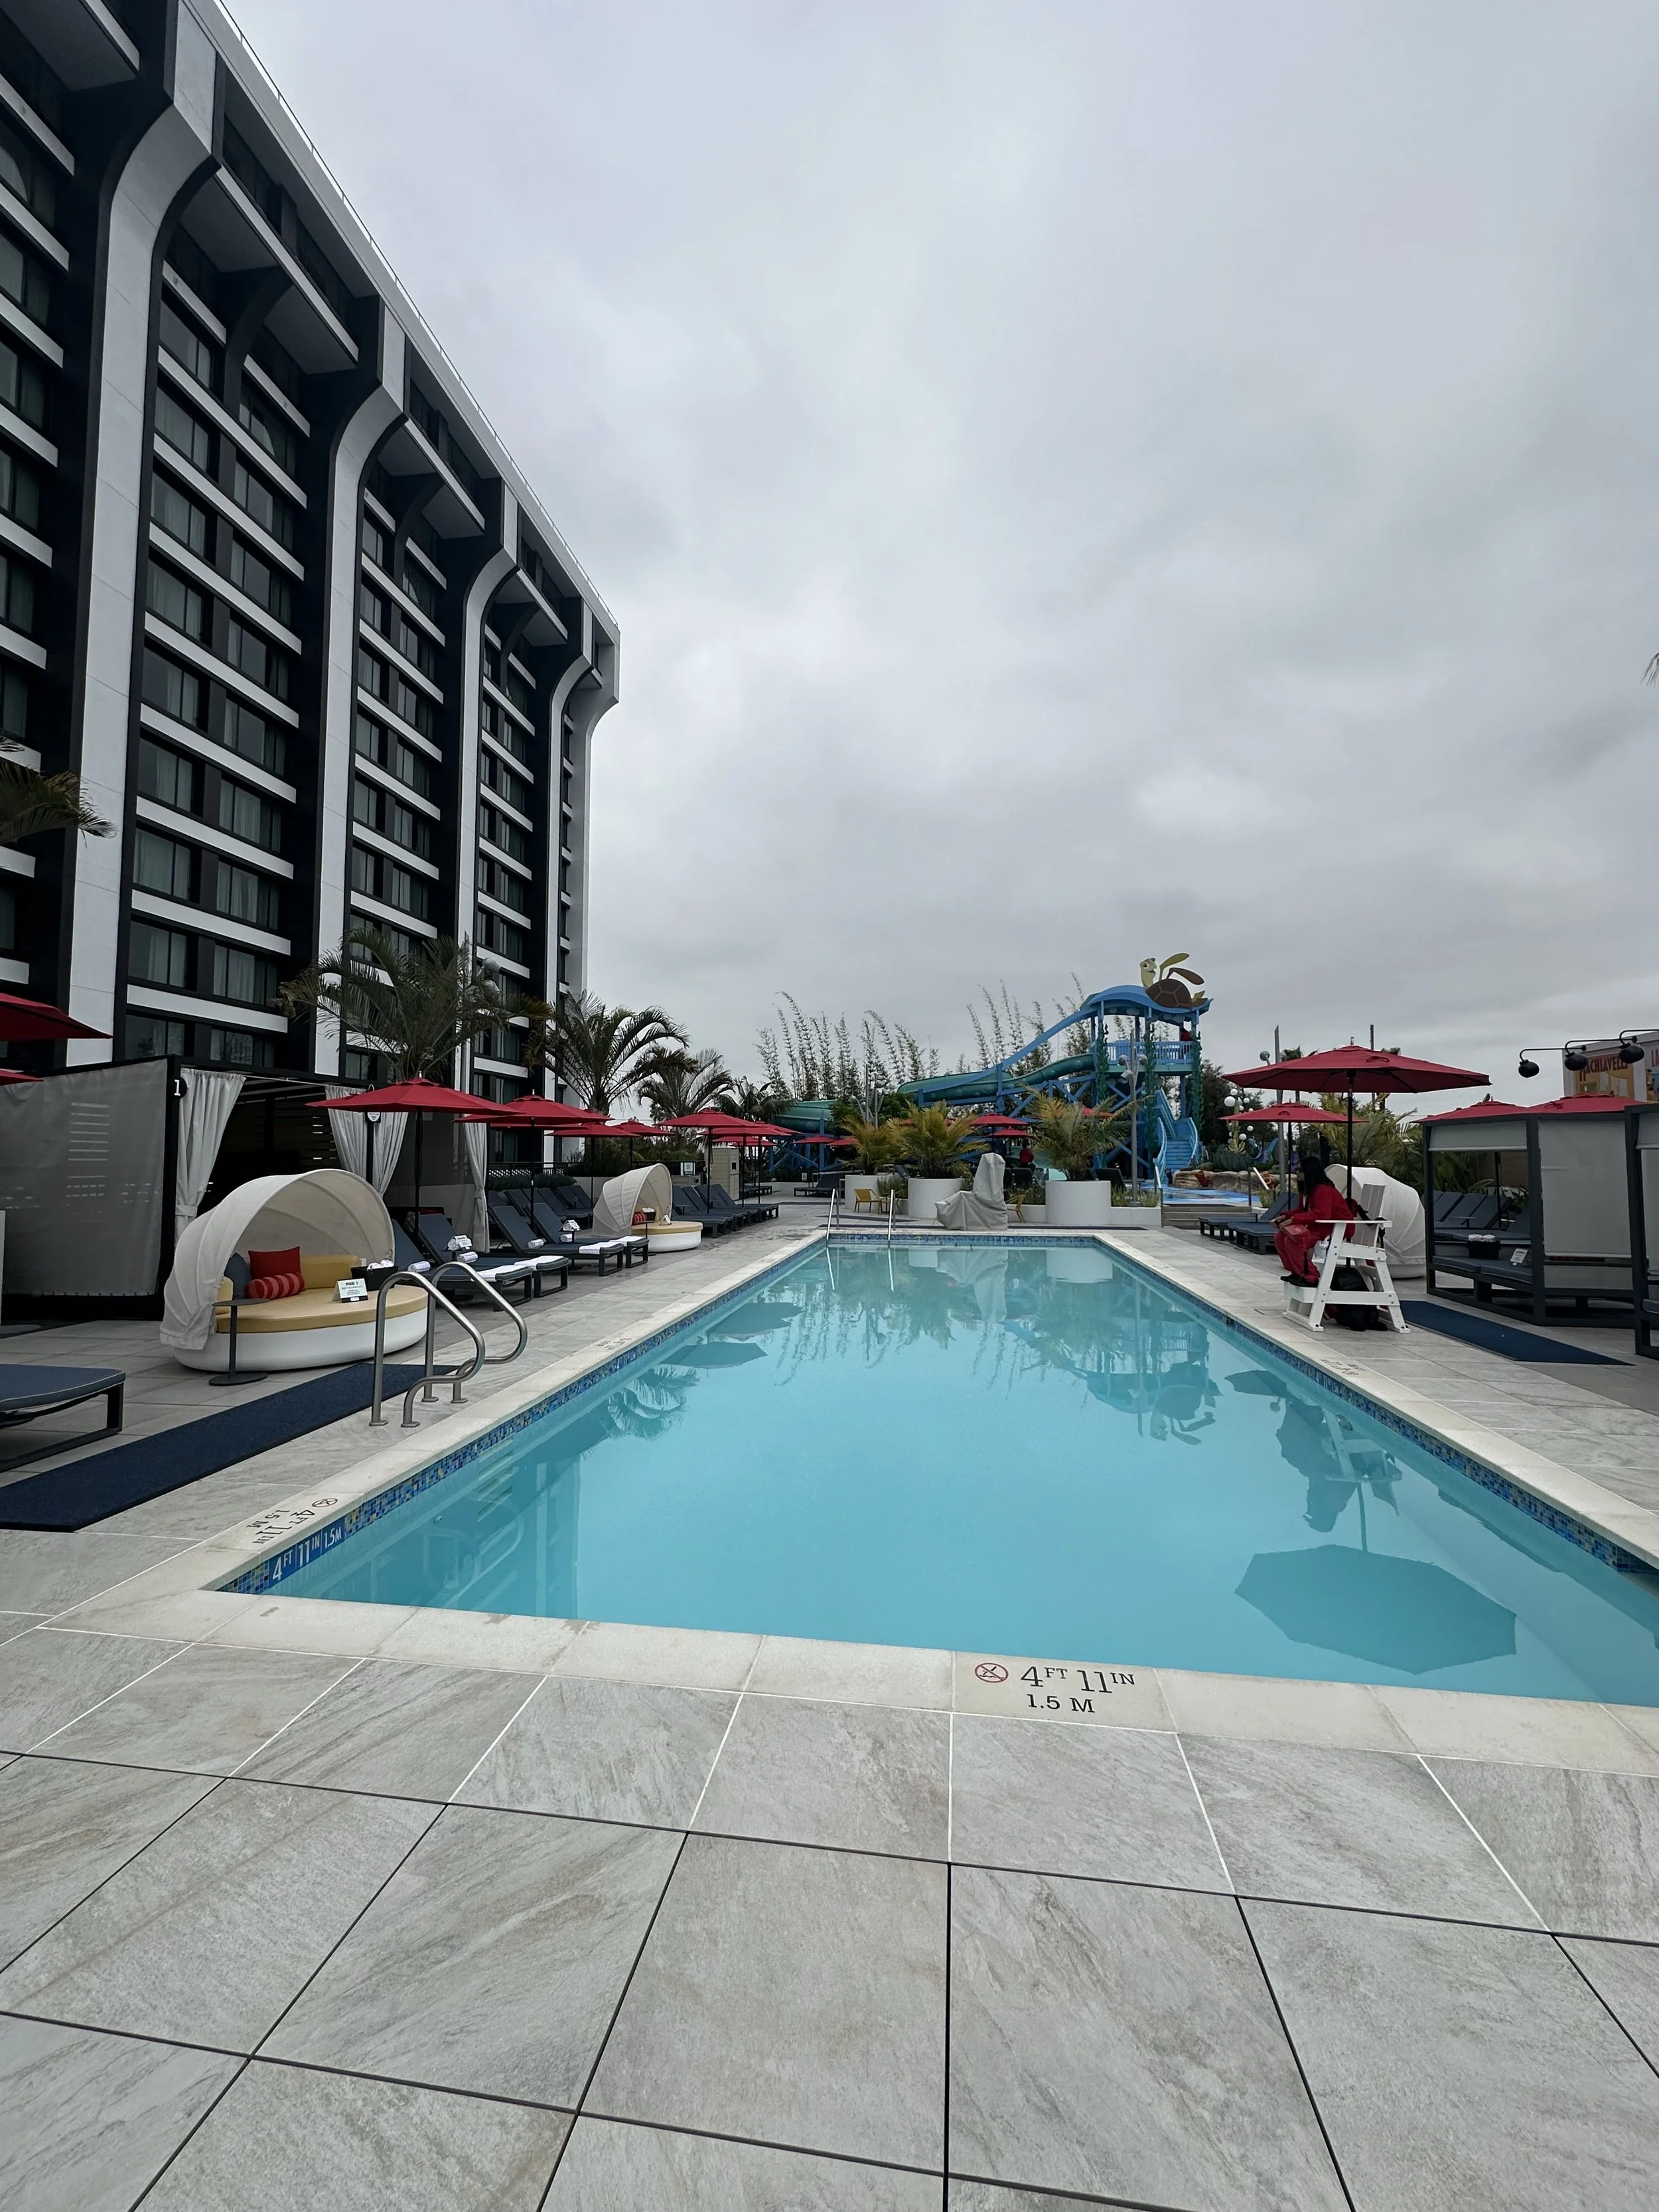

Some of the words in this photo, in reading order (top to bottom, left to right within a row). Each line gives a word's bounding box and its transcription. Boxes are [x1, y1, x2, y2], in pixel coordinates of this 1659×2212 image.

[174, 1079, 180, 1096] 1
[1027, 1694, 1060, 1710] 1.5
[1069, 1697, 1095, 1713] M
